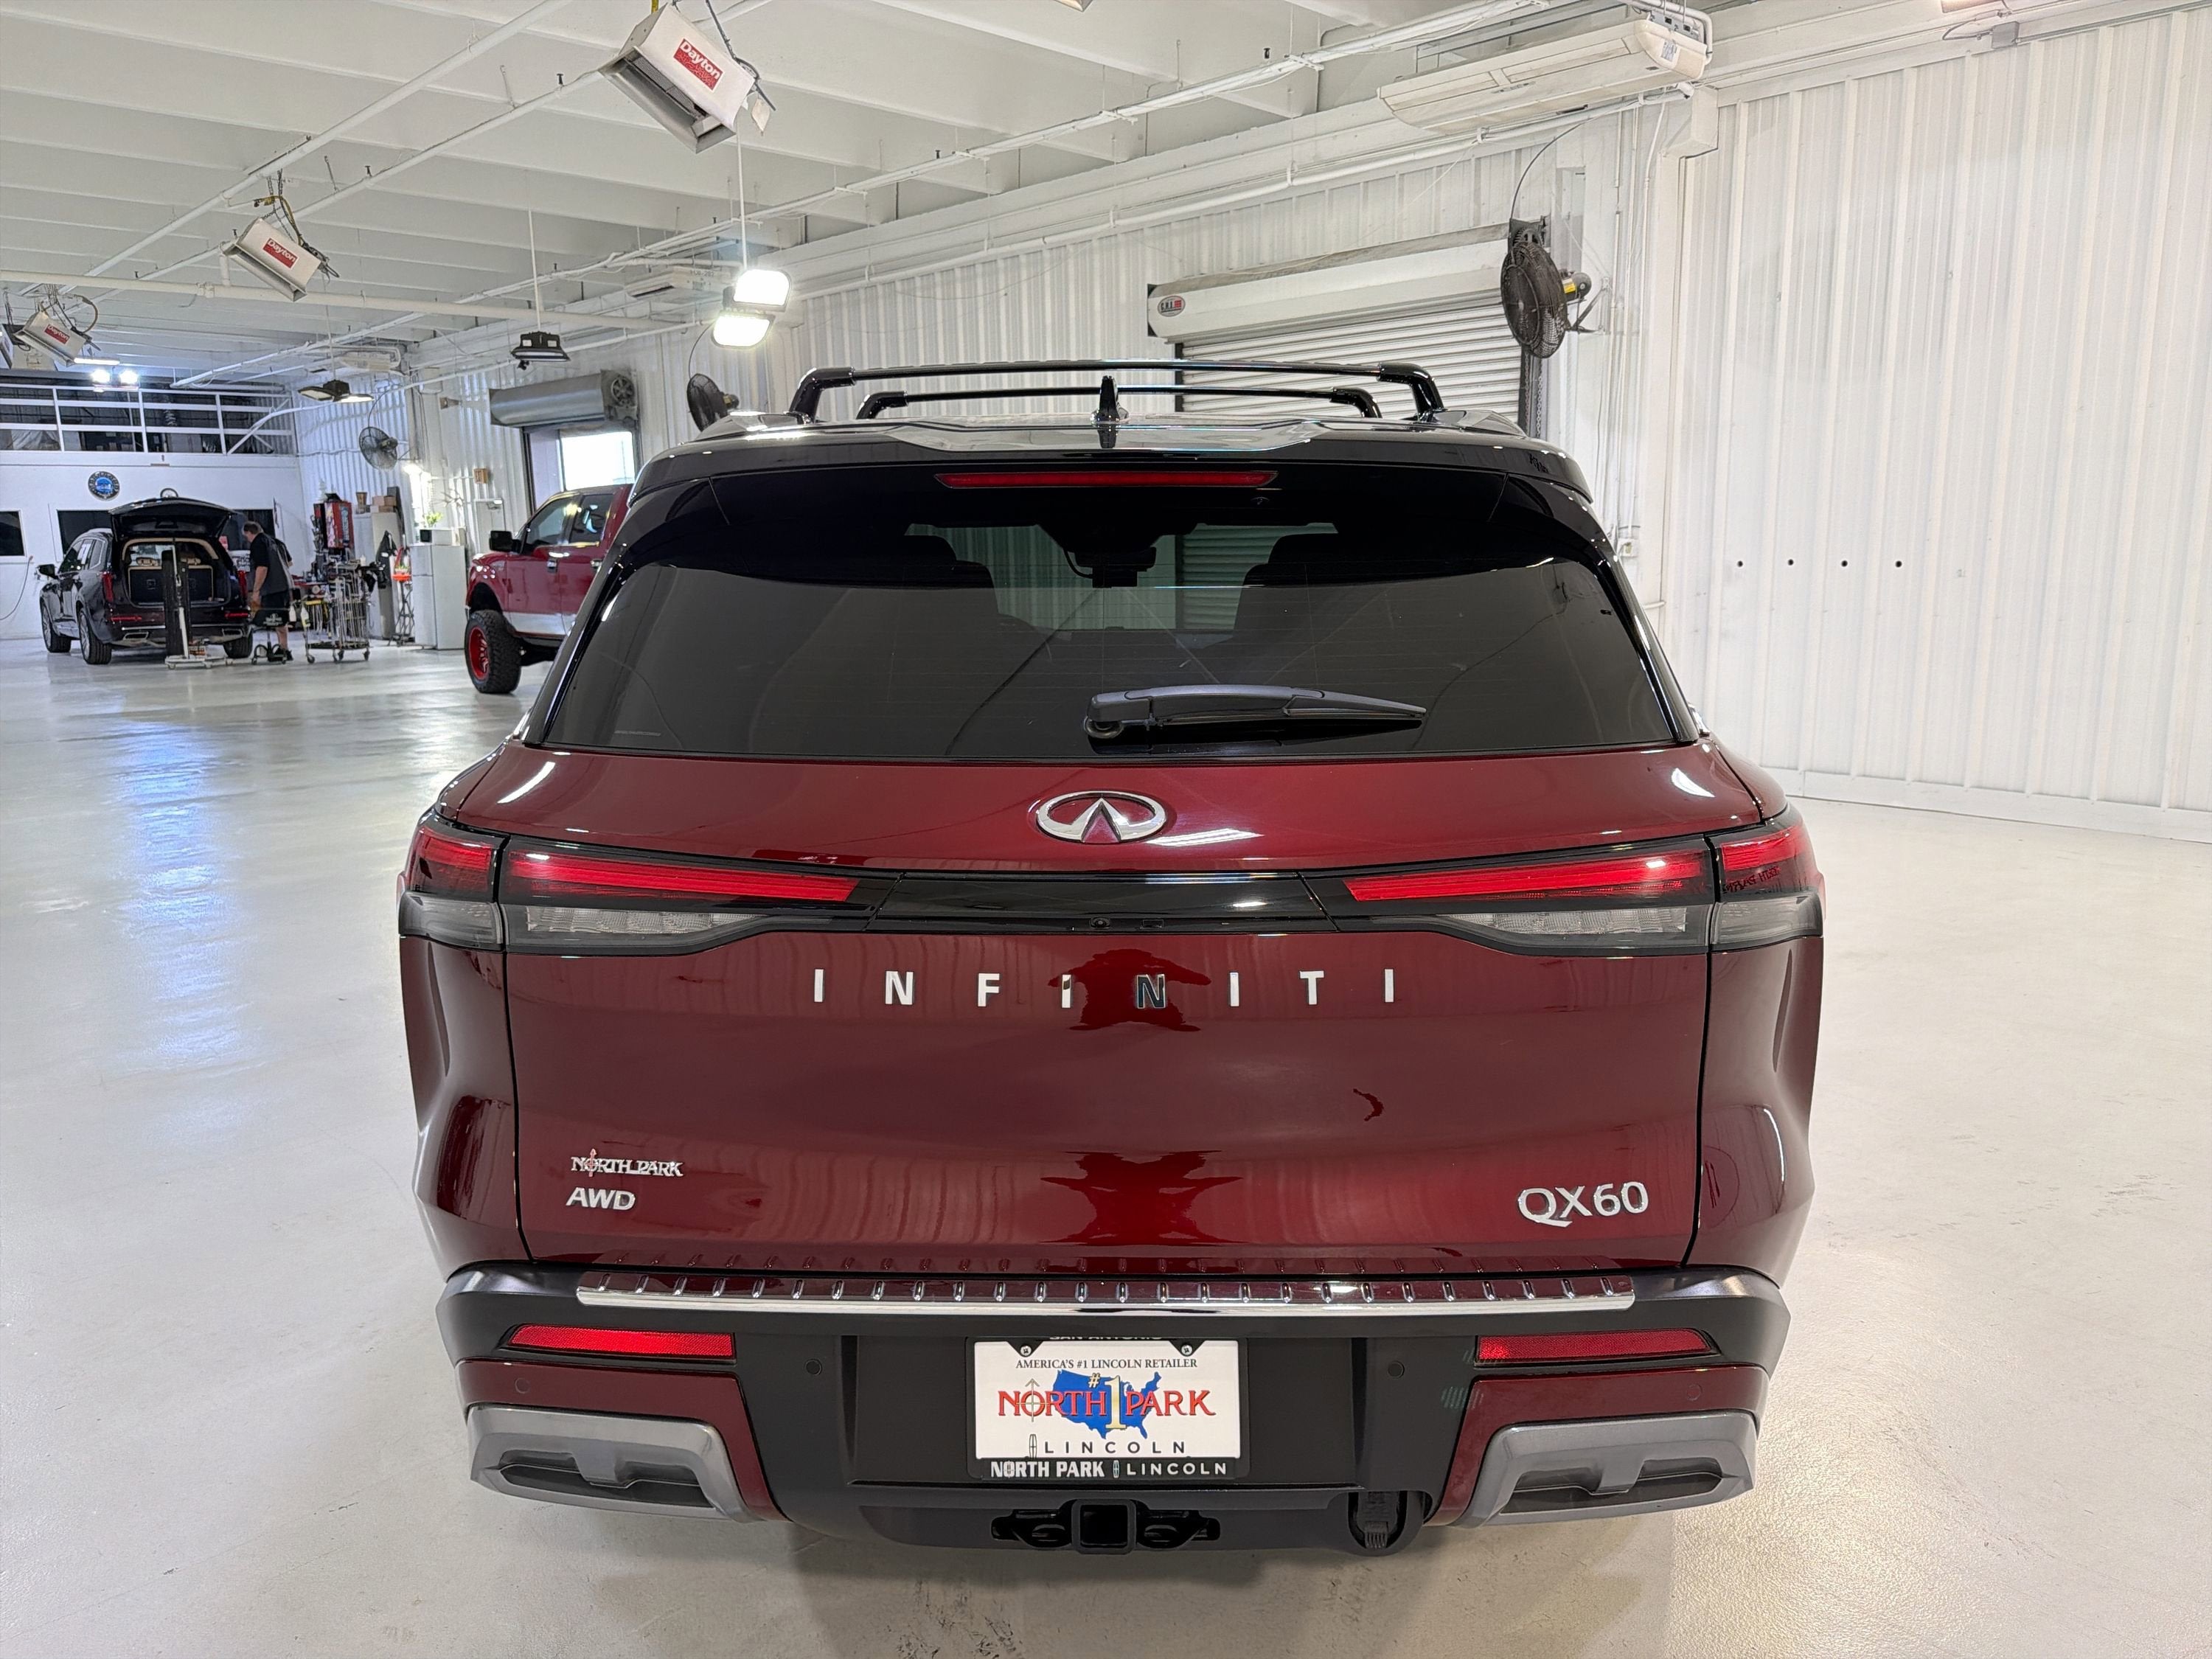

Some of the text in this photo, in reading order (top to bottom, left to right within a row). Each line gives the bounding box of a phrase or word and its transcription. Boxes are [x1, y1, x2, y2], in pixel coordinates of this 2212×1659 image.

[680, 41, 720, 80] Dayton
[267, 240, 296, 262] Dayton
[814, 968, 1394, 1009] INFINITI
[571, 1156, 684, 1177] NORTH PARK
[566, 1186, 636, 1210] AWD
[1518, 1181, 1649, 1227] QX60
[1016, 1358, 1197, 1368] AMERICA'S #1 LINCOLN RETAILER
[998, 1390, 1217, 1416] NORTH PARK
[1045, 1441, 1185, 1454] LINCOLN
[990, 1461, 1227, 1478] NORTH PARK LINCOLN
